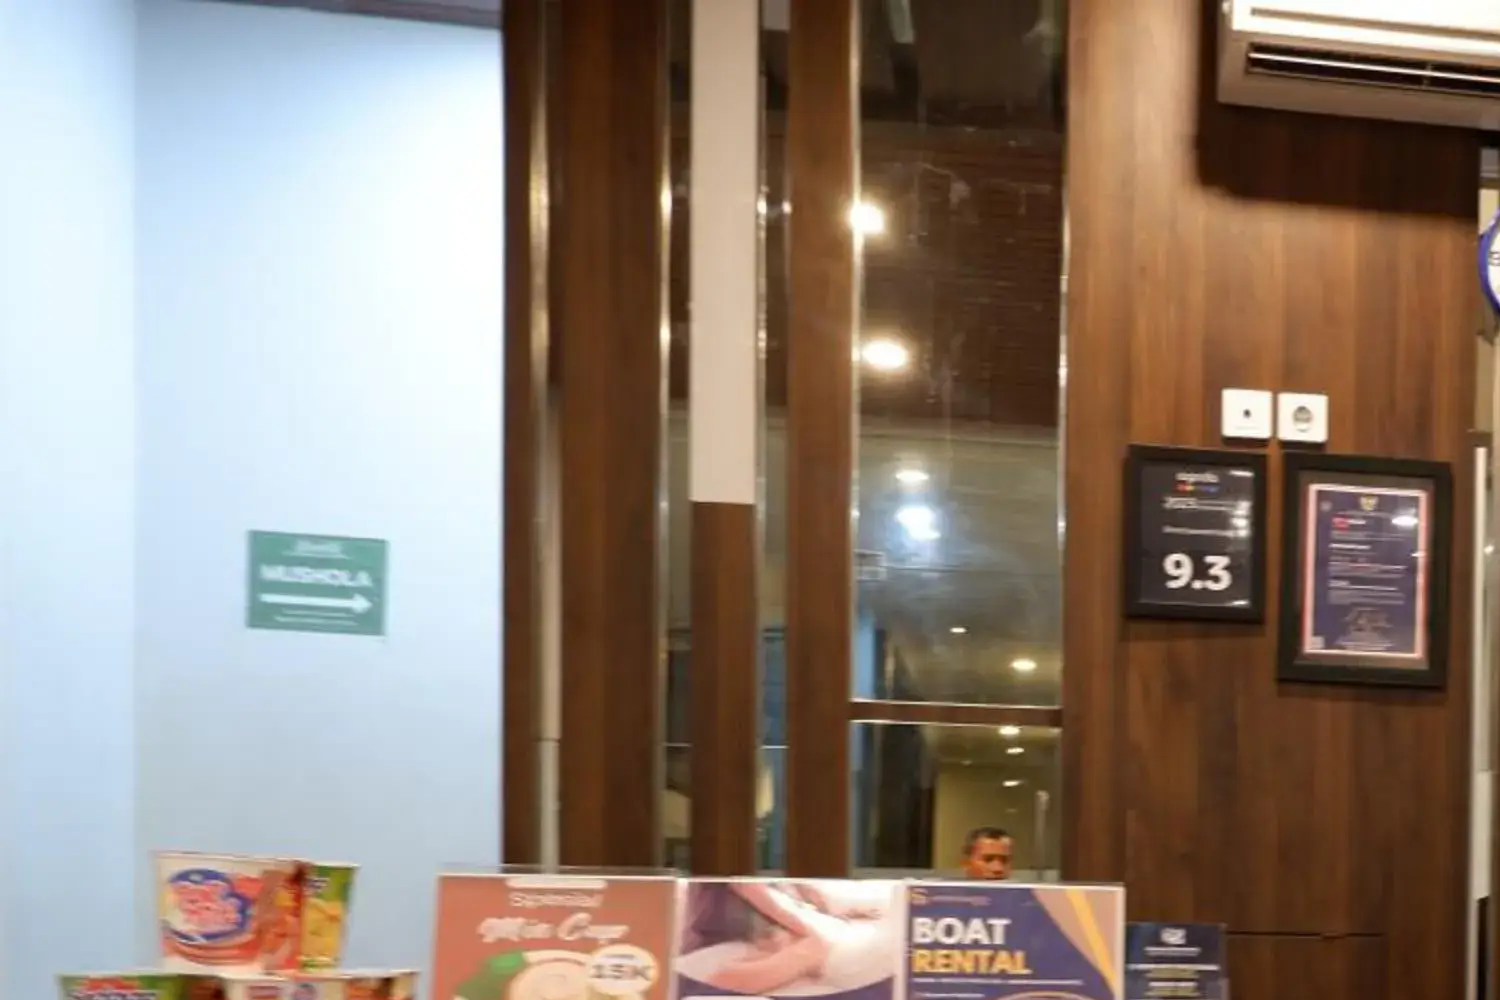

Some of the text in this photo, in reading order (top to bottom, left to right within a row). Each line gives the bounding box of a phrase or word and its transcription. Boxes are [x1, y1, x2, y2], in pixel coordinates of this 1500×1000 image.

[1162, 553, 1233, 592] 9.3
[912, 917, 1012, 945] BOAT
[911, 949, 1032, 975] RENTAL
